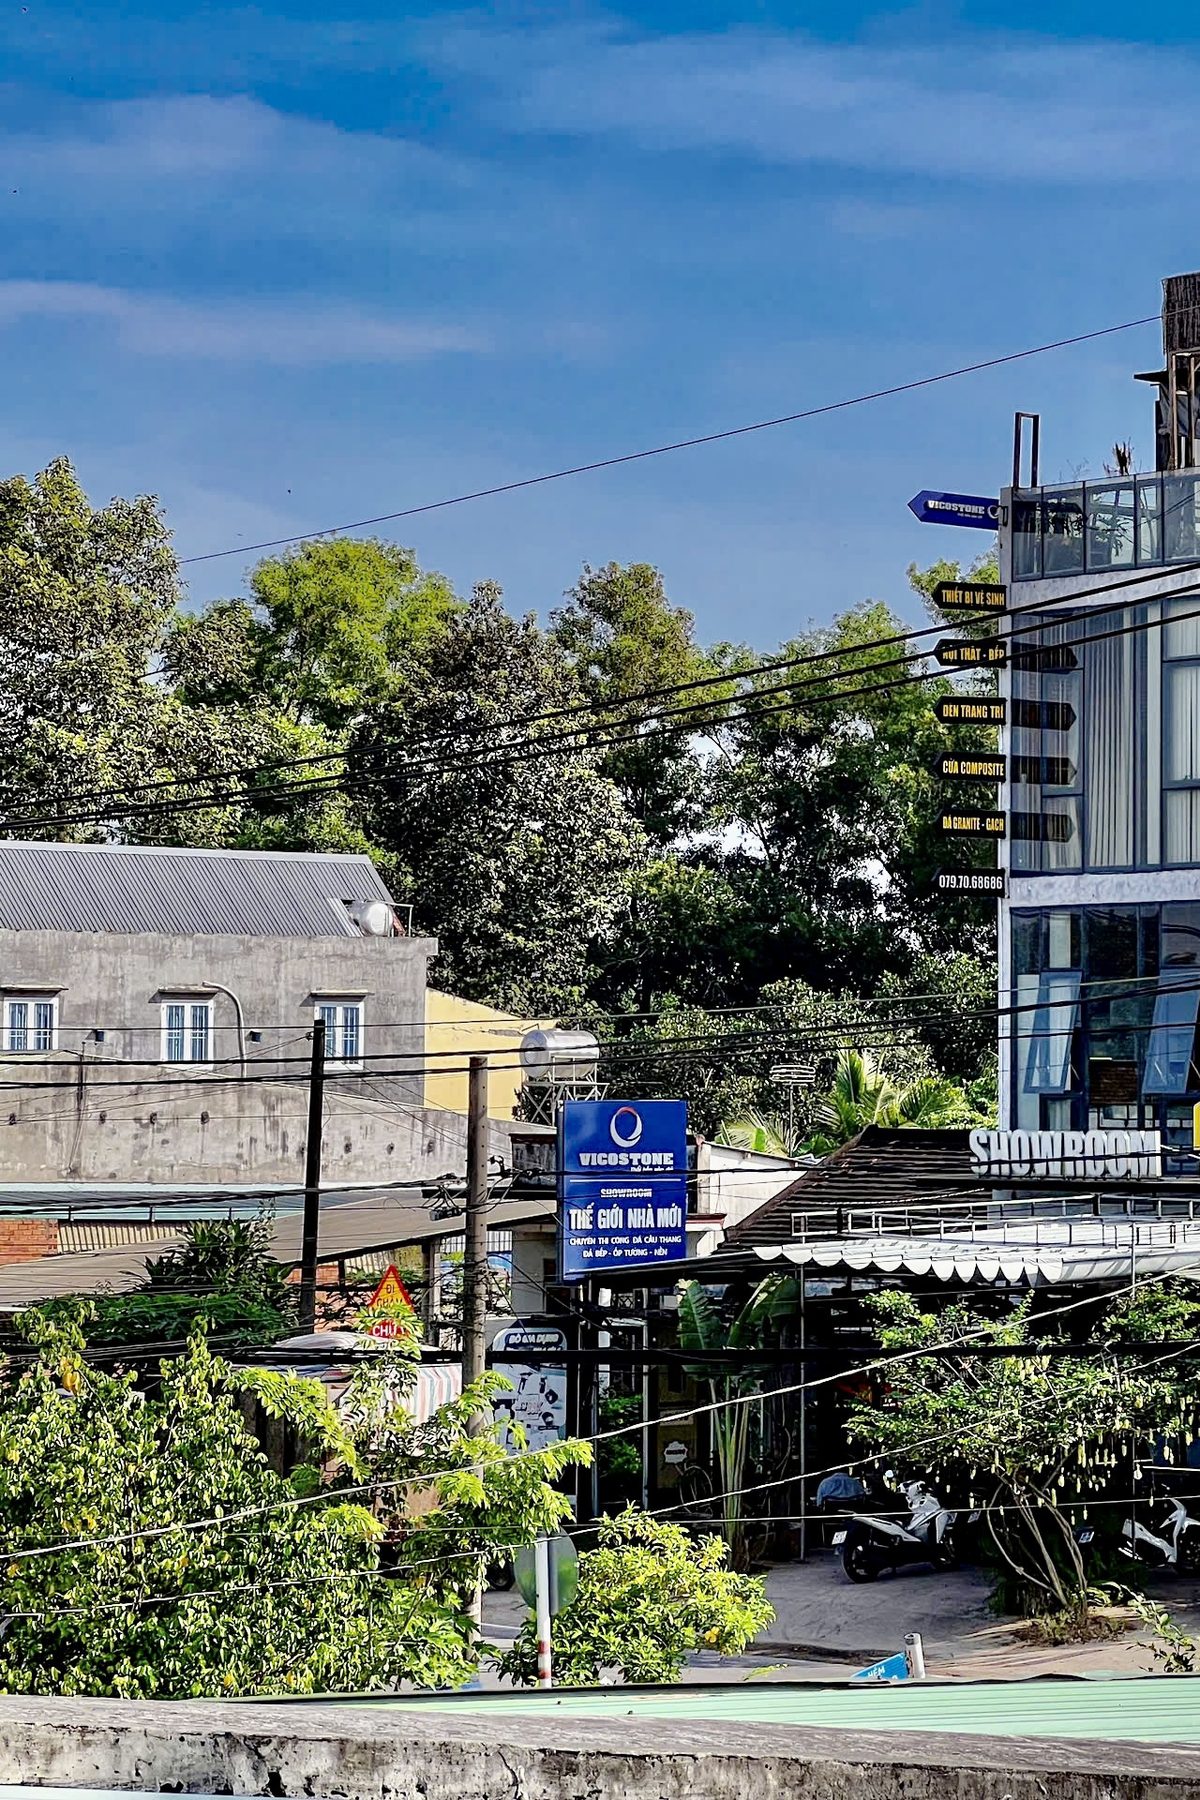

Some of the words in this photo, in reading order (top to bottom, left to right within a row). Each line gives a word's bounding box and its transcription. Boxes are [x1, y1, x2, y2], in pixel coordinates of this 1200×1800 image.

[928, 500, 985, 514] VICOSTONE
[942, 586, 963, 604] THIẾT
[964, 591, 974, 606] BỊ
[975, 589, 985, 607] VỆ
[986, 592, 1005, 606] SINH
[960, 704, 988, 719] TRANG
[989, 703, 1004, 719] TRÍ
[942, 757, 959, 774] CỬA
[960, 760, 1004, 776] COMPOSITE
[953, 816, 981, 830] GRANITE
[939, 874, 1003, 890] 079.70.68686
[579, 1152, 674, 1166] VICOSTONE
[969, 1129, 1161, 1177] SHOWROOM
[600, 1188, 653, 1198] SHOWROOM
[569, 1202, 595, 1230] THẾ
[597, 1203, 624, 1229] GIỚI
[627, 1203, 655, 1229] NHÀ
[657, 1202, 682, 1228] MỚI
[598, 1237, 609, 1245] THI
[633, 1234, 642, 1244] ĐÁ
[659, 1235, 682, 1244] THANG
[583, 1248, 594, 1258] ĐÁ
[613, 1246, 623, 1257] ỐP
[385, 1283, 395, 1294] ĐI
